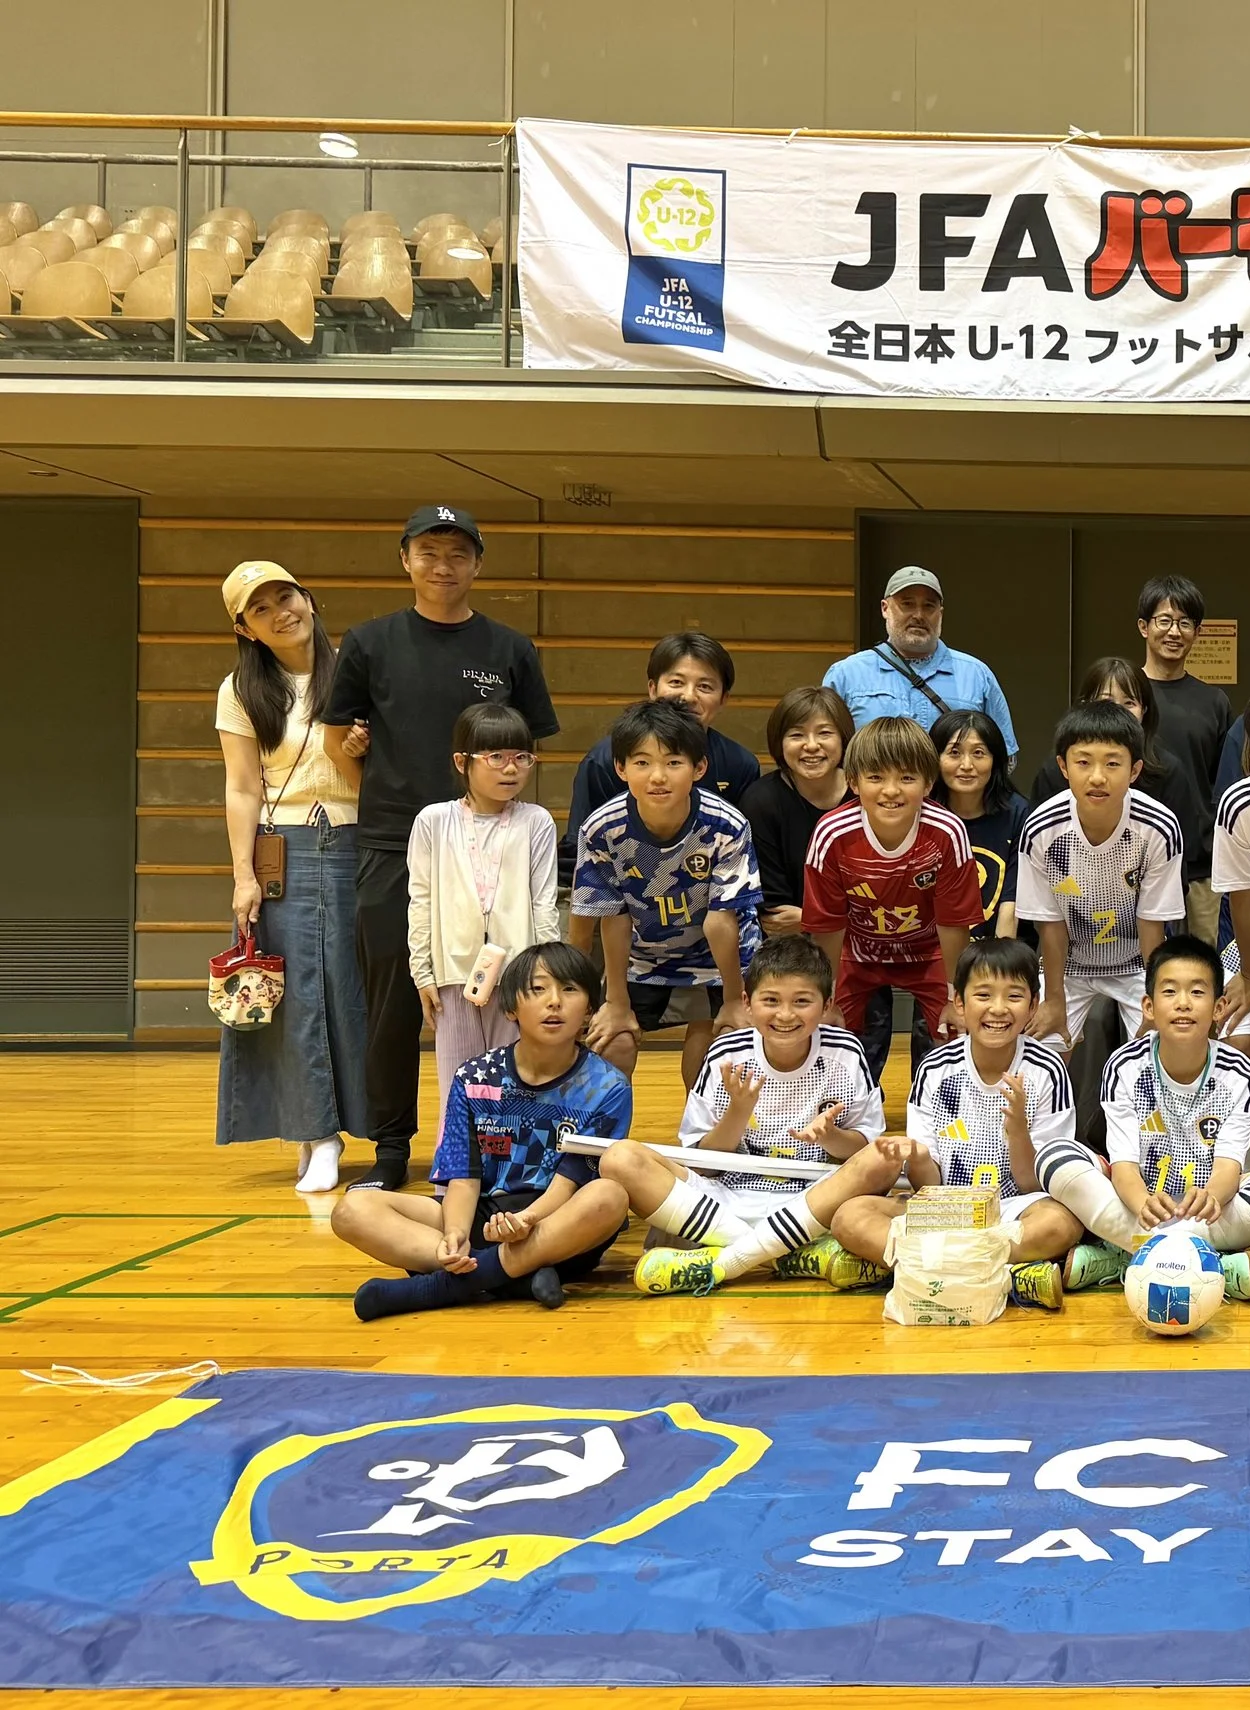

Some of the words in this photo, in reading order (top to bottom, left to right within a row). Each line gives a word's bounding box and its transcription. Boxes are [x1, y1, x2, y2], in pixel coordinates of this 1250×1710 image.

[657, 206, 696, 225] U-12
[662, 278, 689, 293] JFA
[660, 295, 693, 310] U-12
[635, 316, 714, 336] CHAMPIONSHIP
[644, 305, 707, 326] FUTSAL
[654, 891, 692, 926] 14
[1091, 909, 1118, 945] 2
[1156, 1261, 1186, 1271] molten
[846, 1438, 1229, 1512] FC
[796, 1527, 1213, 1567] STAY
[248, 1548, 511, 1575] PORTA
